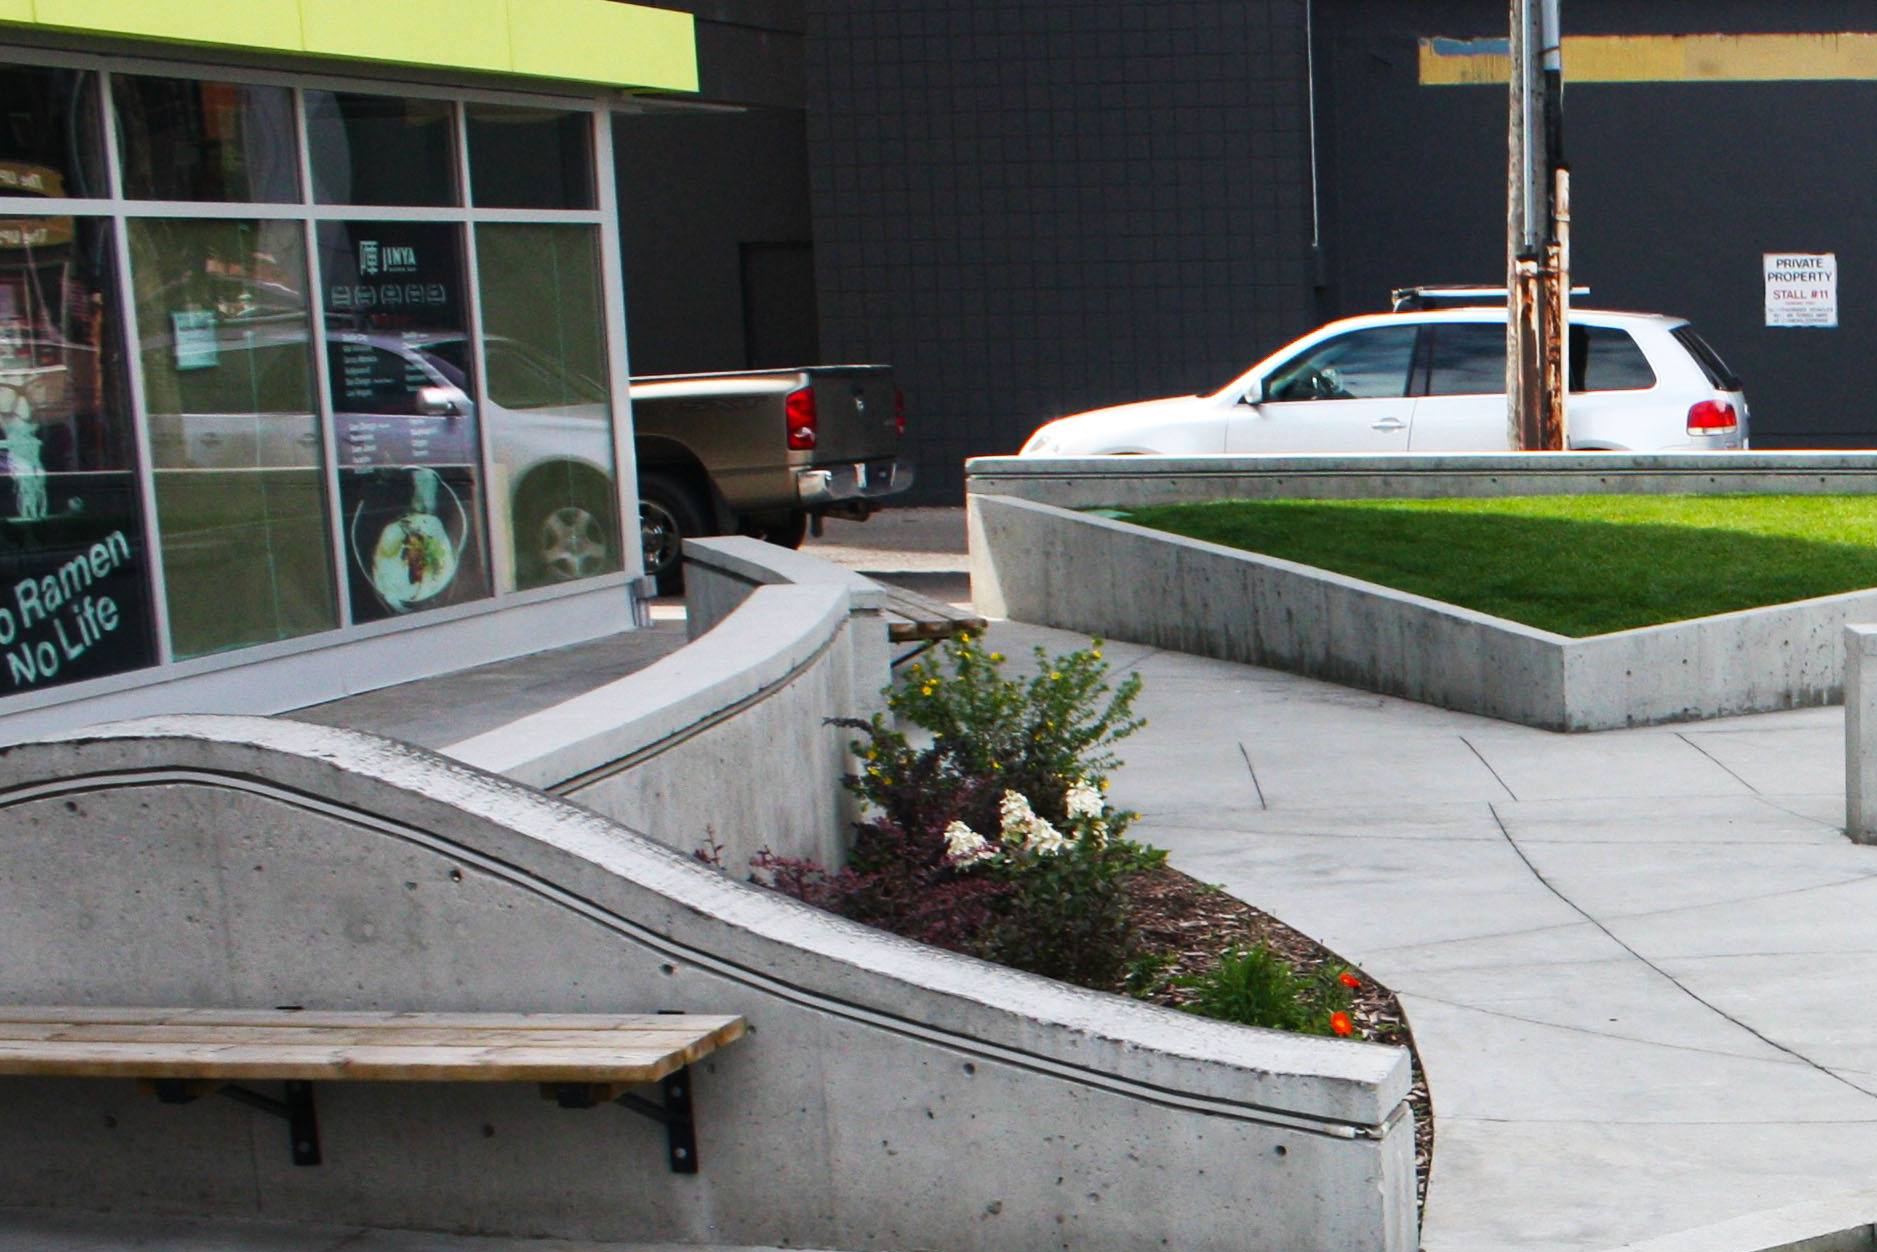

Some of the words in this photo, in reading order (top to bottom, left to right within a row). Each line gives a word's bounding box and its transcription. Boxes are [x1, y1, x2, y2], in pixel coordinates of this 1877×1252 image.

[382, 247, 417, 272] JINYA
[1776, 258, 1824, 268] PRIVATE
[1767, 271, 1832, 282] PROPERTY
[1773, 289, 1807, 300] STALL
[0, 607, 16, 644] o
[14, 530, 131, 629] Ramen
[6, 641, 60, 687] No
[53, 596, 120, 661] Life
